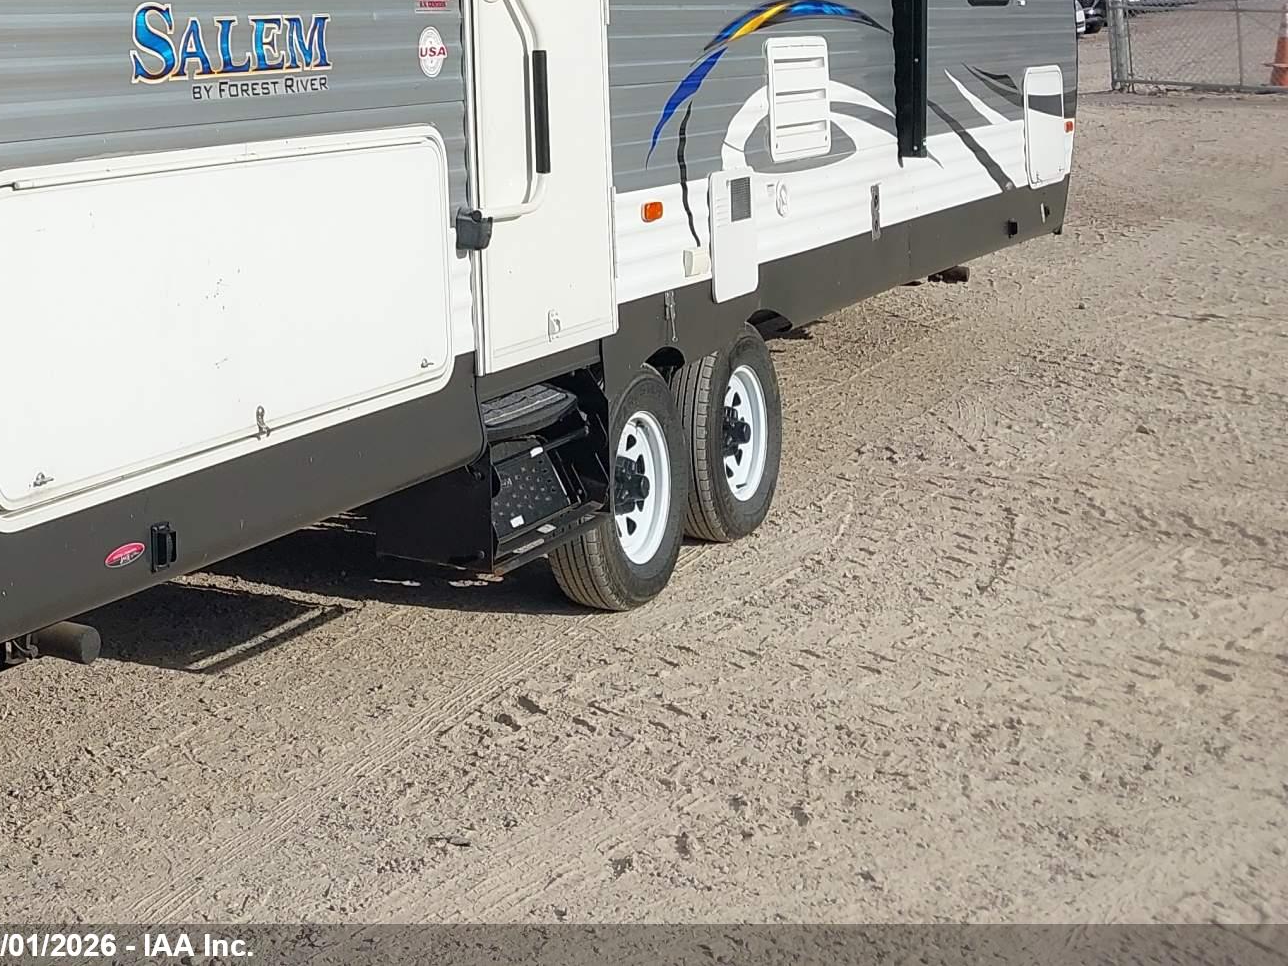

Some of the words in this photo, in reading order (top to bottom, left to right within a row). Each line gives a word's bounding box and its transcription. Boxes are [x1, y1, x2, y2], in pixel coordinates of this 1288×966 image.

[130, 1, 332, 83] SALEM
[419, 46, 447, 58] USA
[192, 84, 213, 100] BY
[218, 80, 280, 99] FOREST
[284, 77, 329, 94] RIVER
